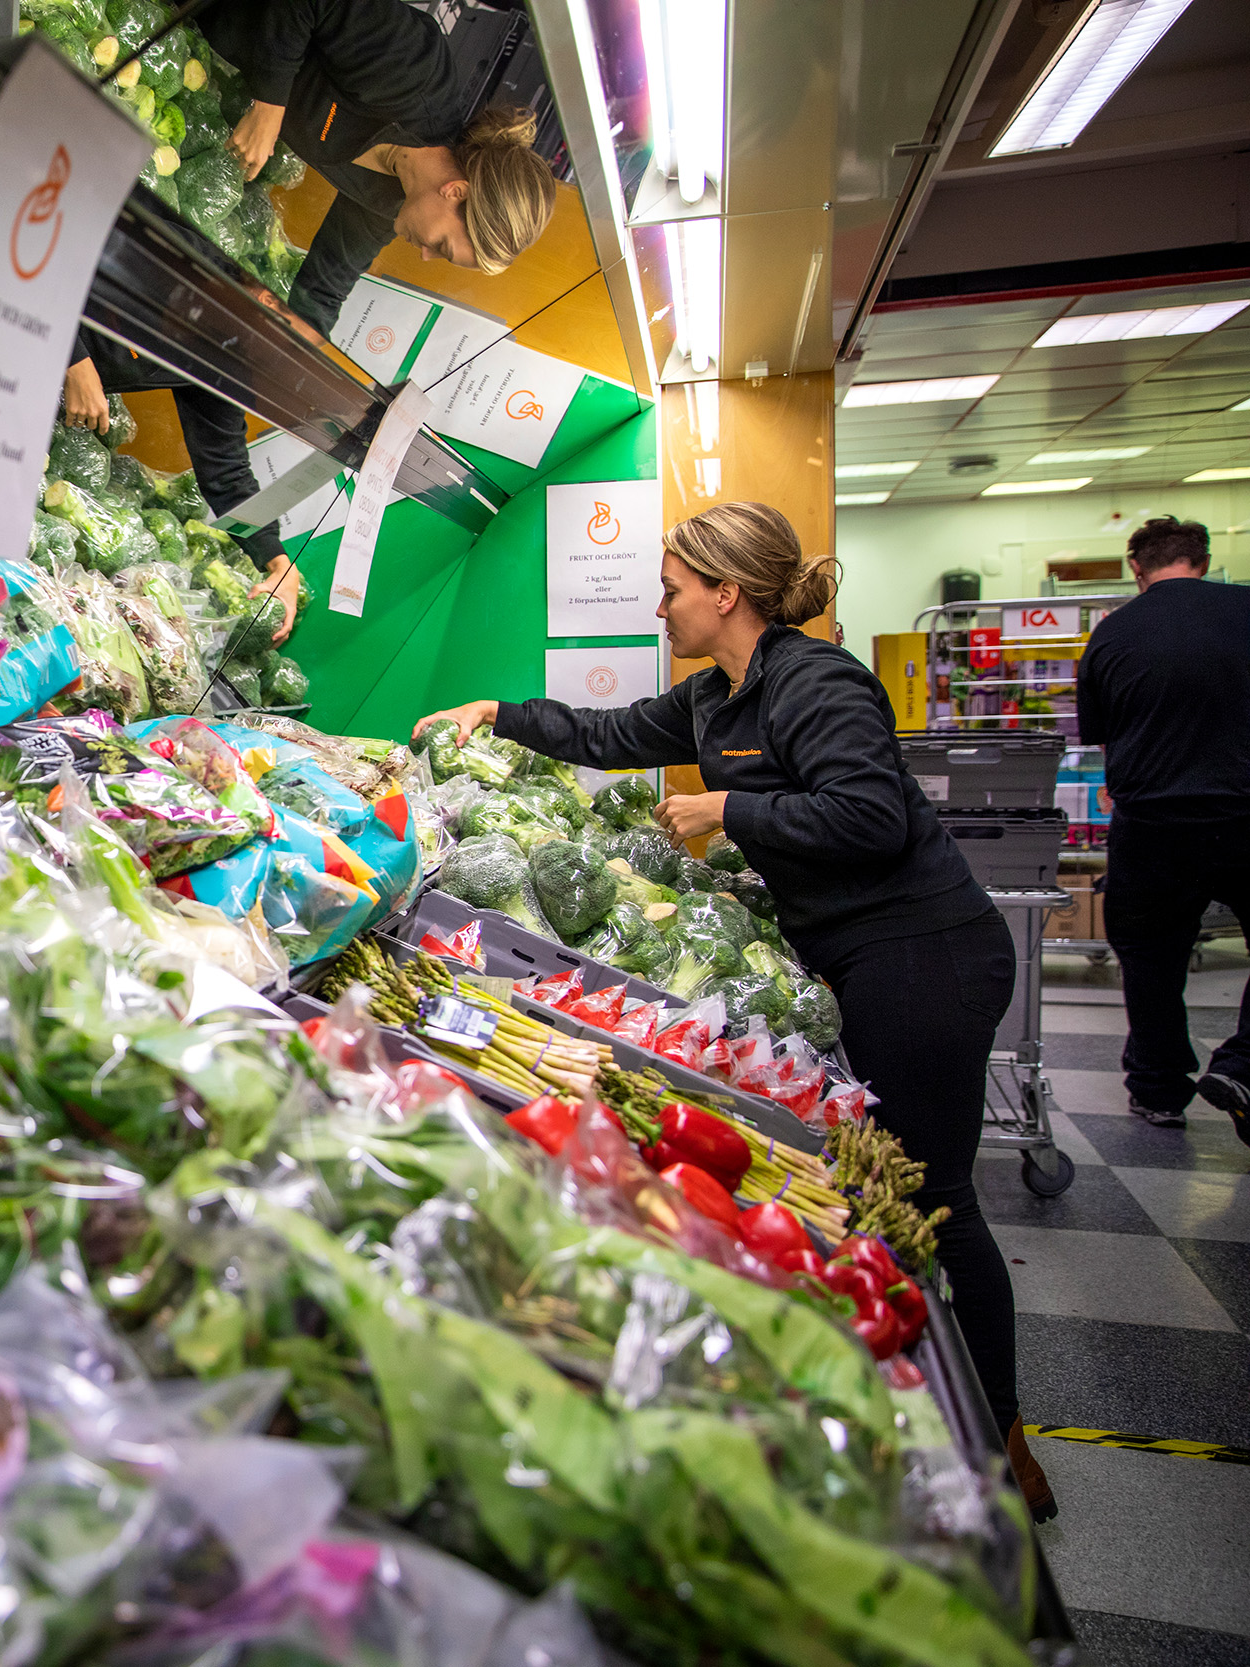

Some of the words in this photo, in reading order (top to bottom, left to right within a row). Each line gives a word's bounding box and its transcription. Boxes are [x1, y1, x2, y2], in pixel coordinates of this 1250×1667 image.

[611, 552, 637, 560] GRÖNT
[591, 574, 622, 583] kg/kund
[574, 595, 639, 605] förpackning/kund
[1021, 609, 1058, 627] ICA
